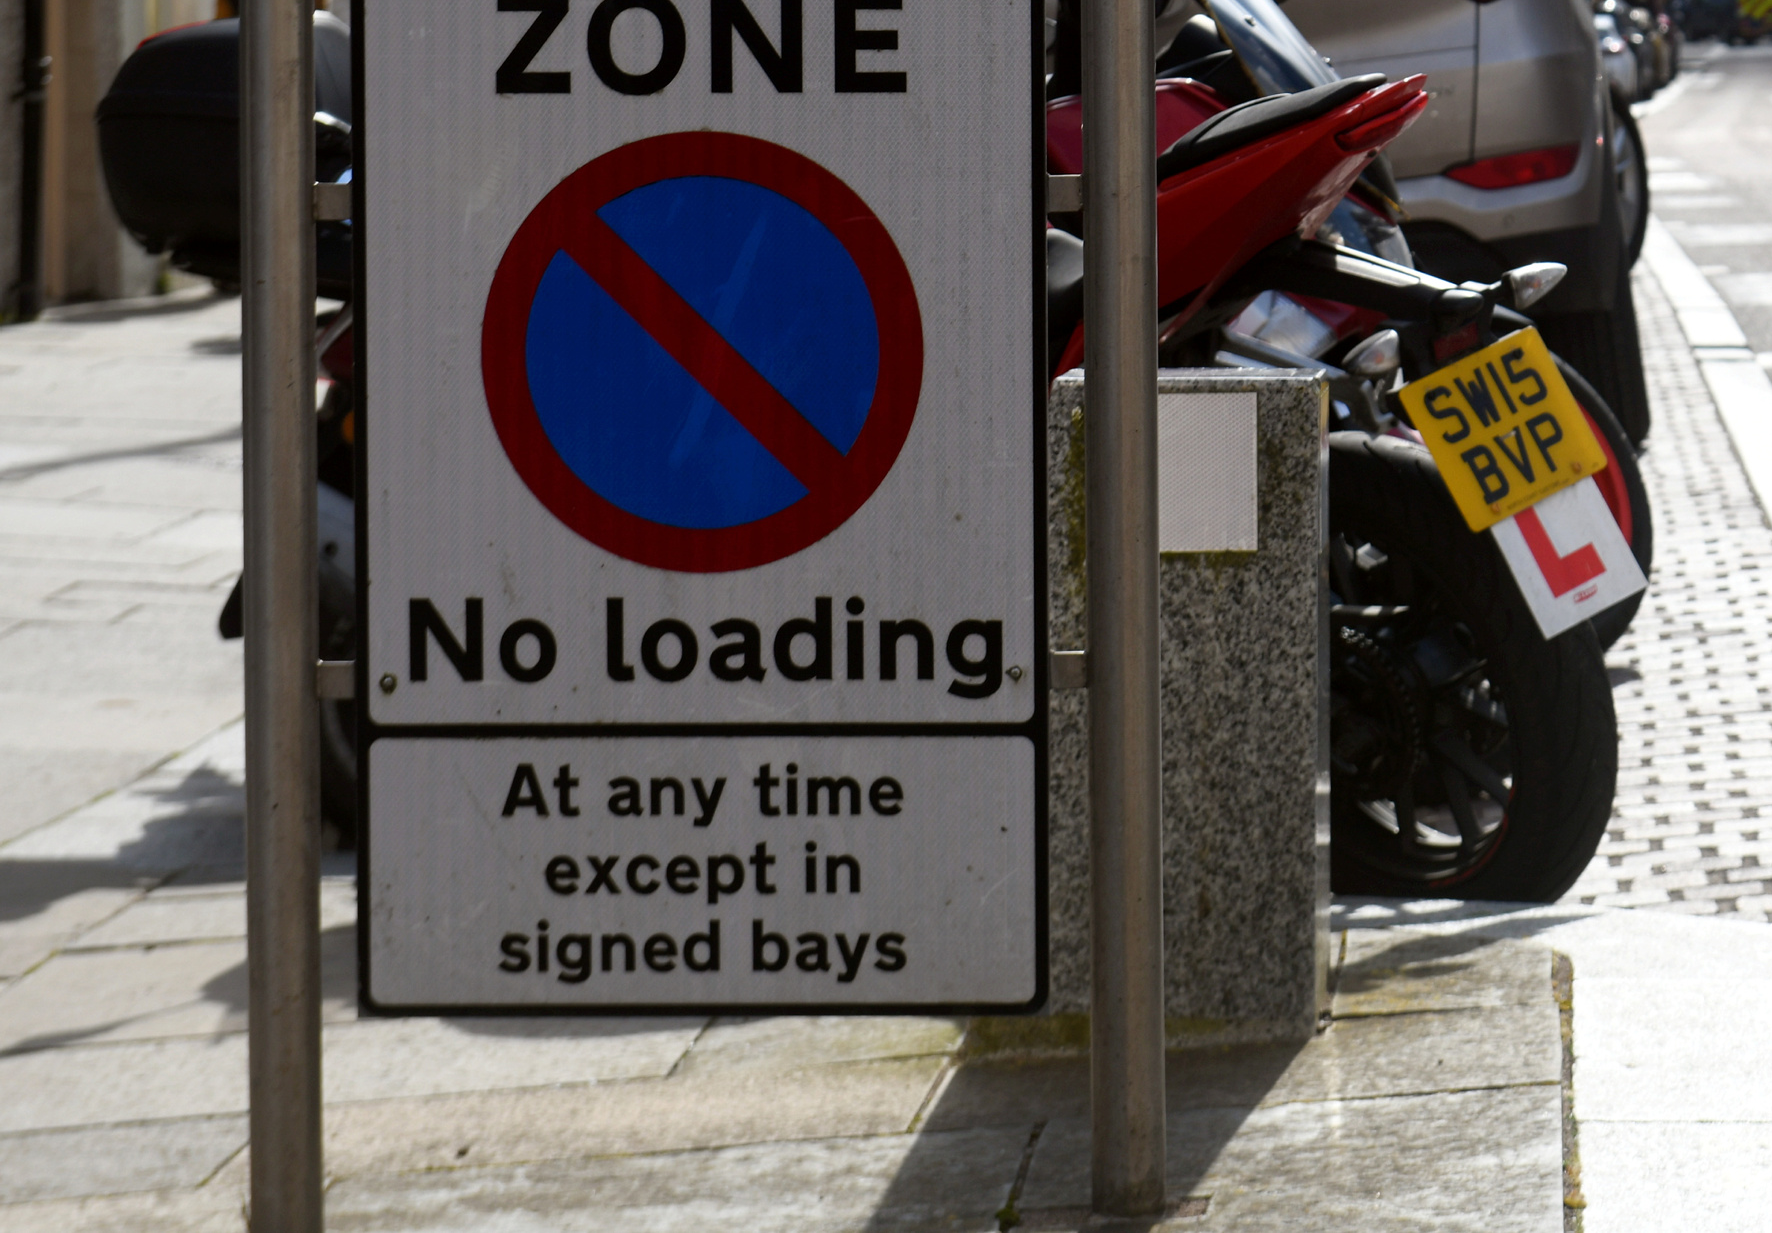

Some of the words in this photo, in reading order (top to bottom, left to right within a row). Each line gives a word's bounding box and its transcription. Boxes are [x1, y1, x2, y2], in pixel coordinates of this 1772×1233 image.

[1422, 347, 1548, 445] SW15
[1461, 411, 1565, 507] BVP
[1513, 506, 1607, 599] L
[408, 597, 558, 684] No
[606, 597, 1004, 700] loading
[500, 763, 581, 818] At
[607, 776, 727, 826] any
[752, 763, 906, 818] time
[543, 842, 777, 905] except
[805, 841, 862, 895] in
[498, 920, 721, 983] signed
[751, 920, 909, 983] bays
